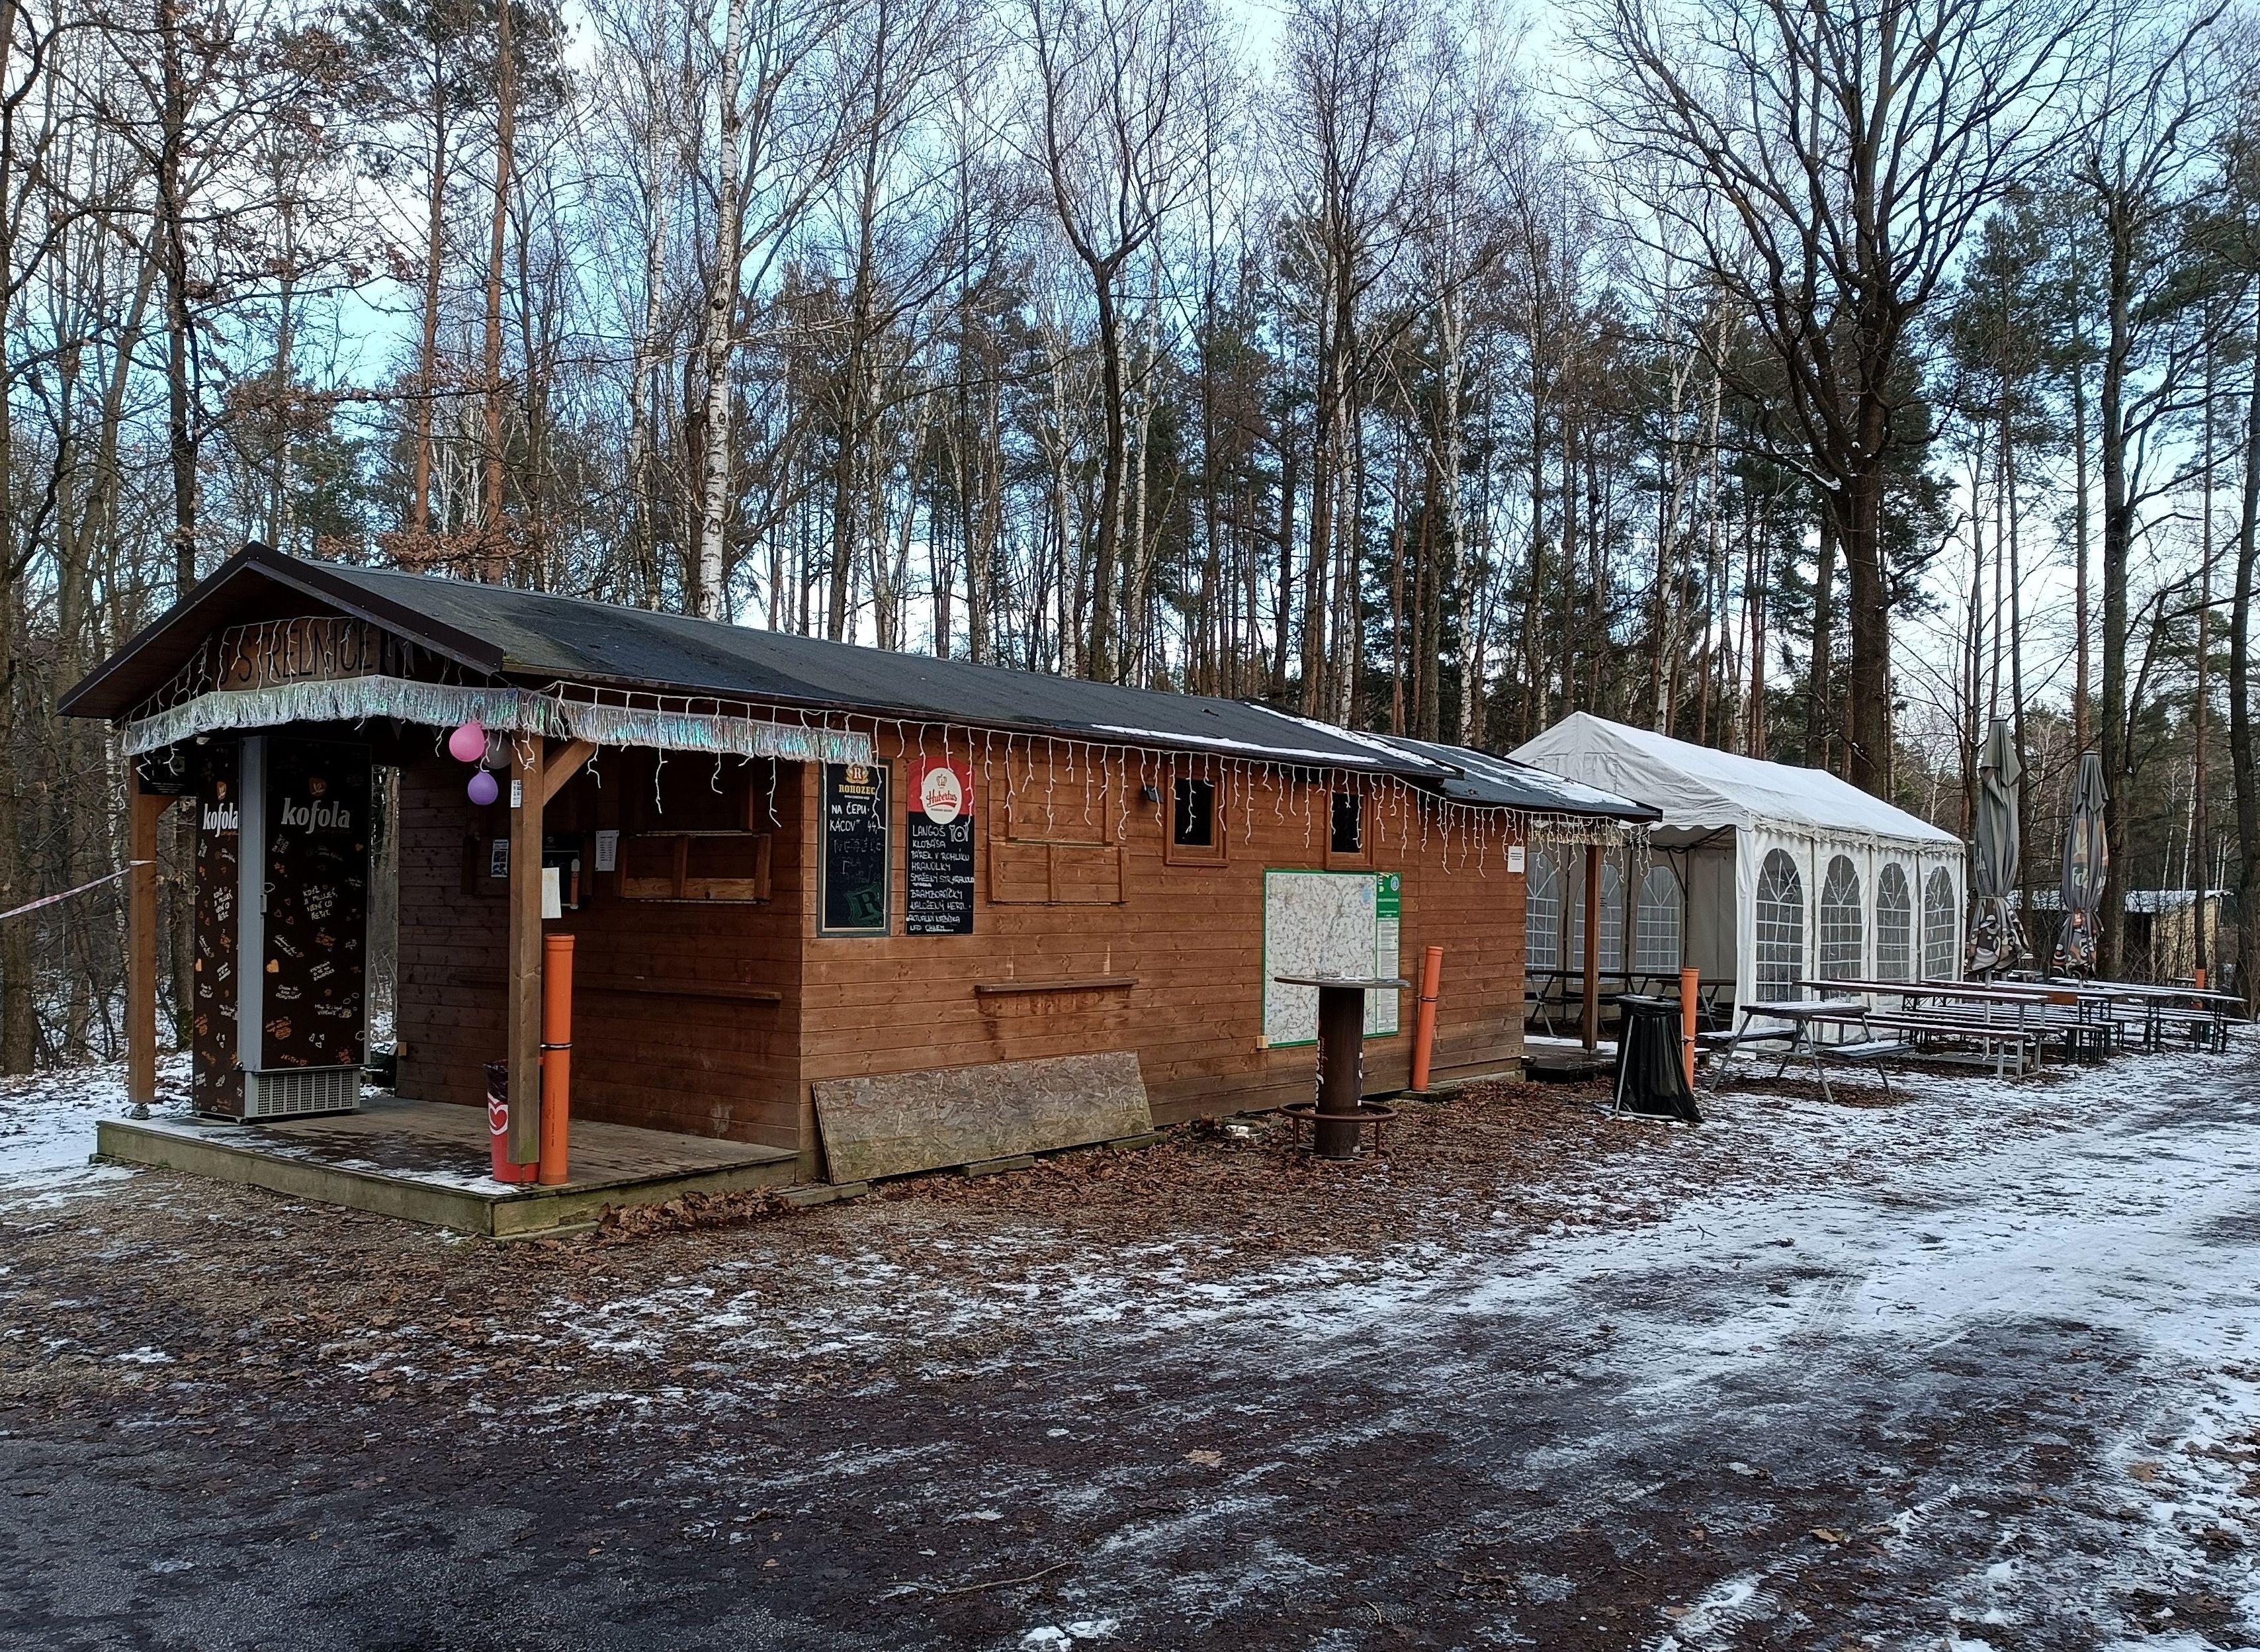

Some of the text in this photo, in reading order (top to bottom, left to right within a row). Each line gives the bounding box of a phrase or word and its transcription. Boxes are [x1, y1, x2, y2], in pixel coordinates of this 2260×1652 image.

[853, 767, 862, 779] R
[838, 784, 876, 795] ROHOZEC
[926, 789, 957, 805] Hubertus
[281, 797, 351, 834] kofola
[831, 804, 842, 814] NA
[202, 803, 238, 838] kofola
[829, 818, 855, 832] KÁCOV
[912, 824, 946, 837] LANGOŠ
[912, 838, 946, 848] KLOBÁSA
[910, 849, 933, 859] PÁREK
[941, 848, 970, 861] ROHLÍKU
[911, 861, 951, 871] HRANOLKY
